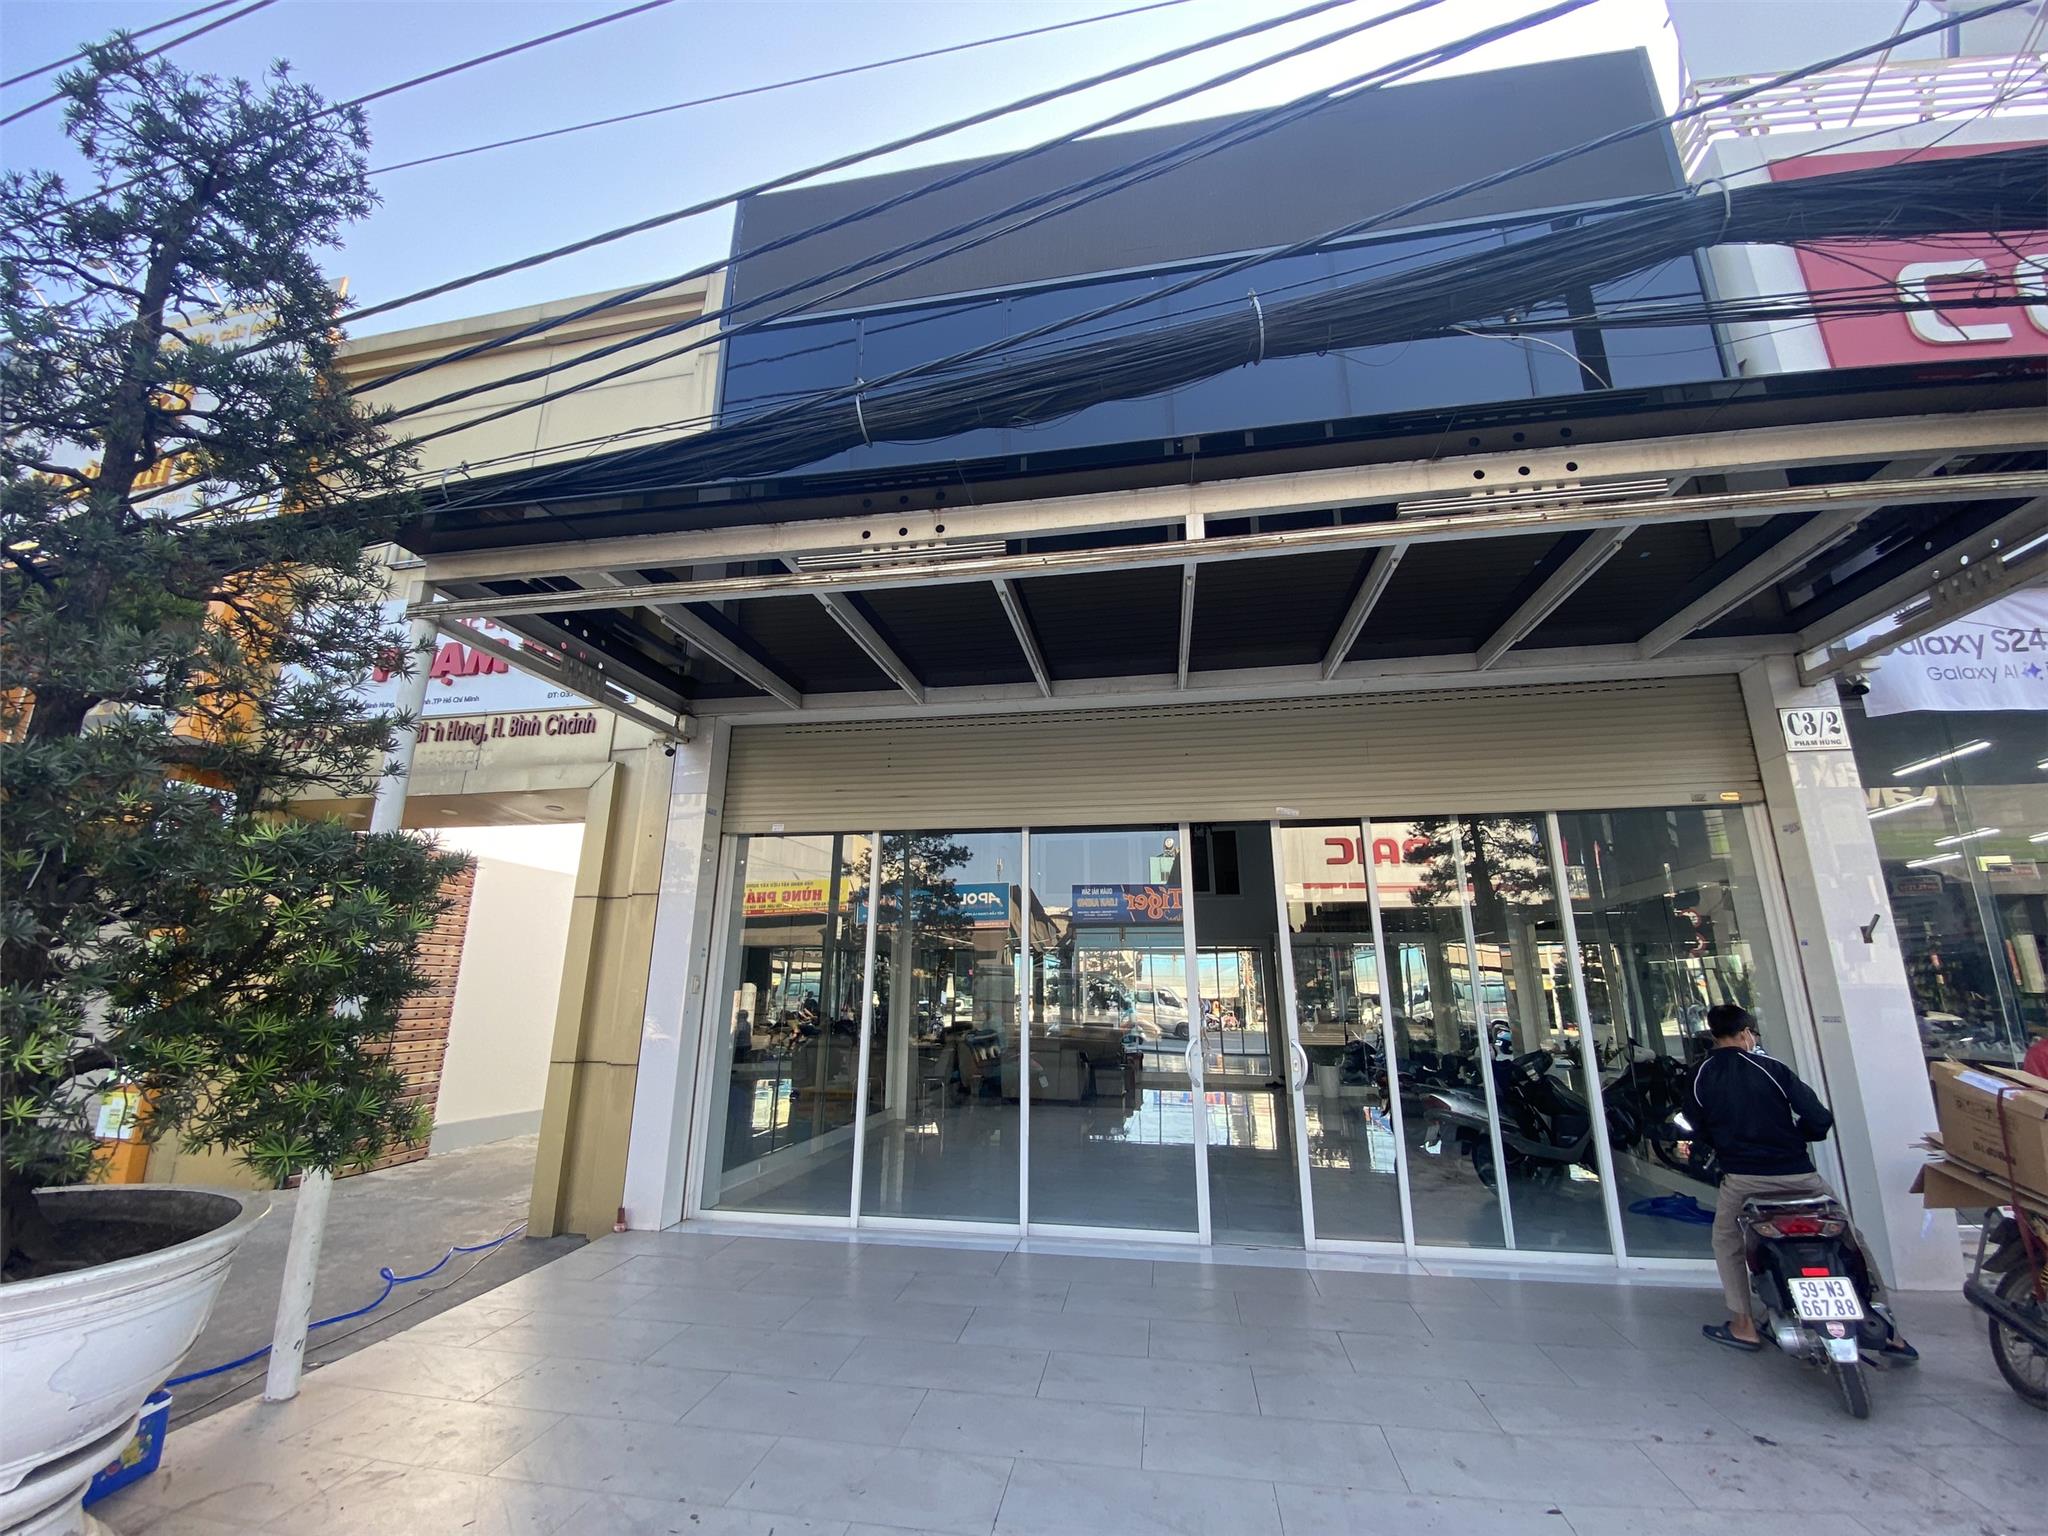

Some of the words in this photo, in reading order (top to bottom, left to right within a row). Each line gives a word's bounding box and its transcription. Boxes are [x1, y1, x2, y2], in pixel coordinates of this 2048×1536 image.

[1867, 634, 1984, 660] alaxy
[1991, 628, 2047, 653] S24
[1926, 666, 1997, 684] Galaxy
[2005, 664, 2018, 678] AI
[491, 717, 505, 738] H.
[508, 714, 541, 737] Bình
[544, 711, 597, 736] Chánh
[1787, 711, 1841, 738] C3/2
[1799, 1281, 1845, 1298] 59-N3
[1801, 1299, 1857, 1316] 667.88
